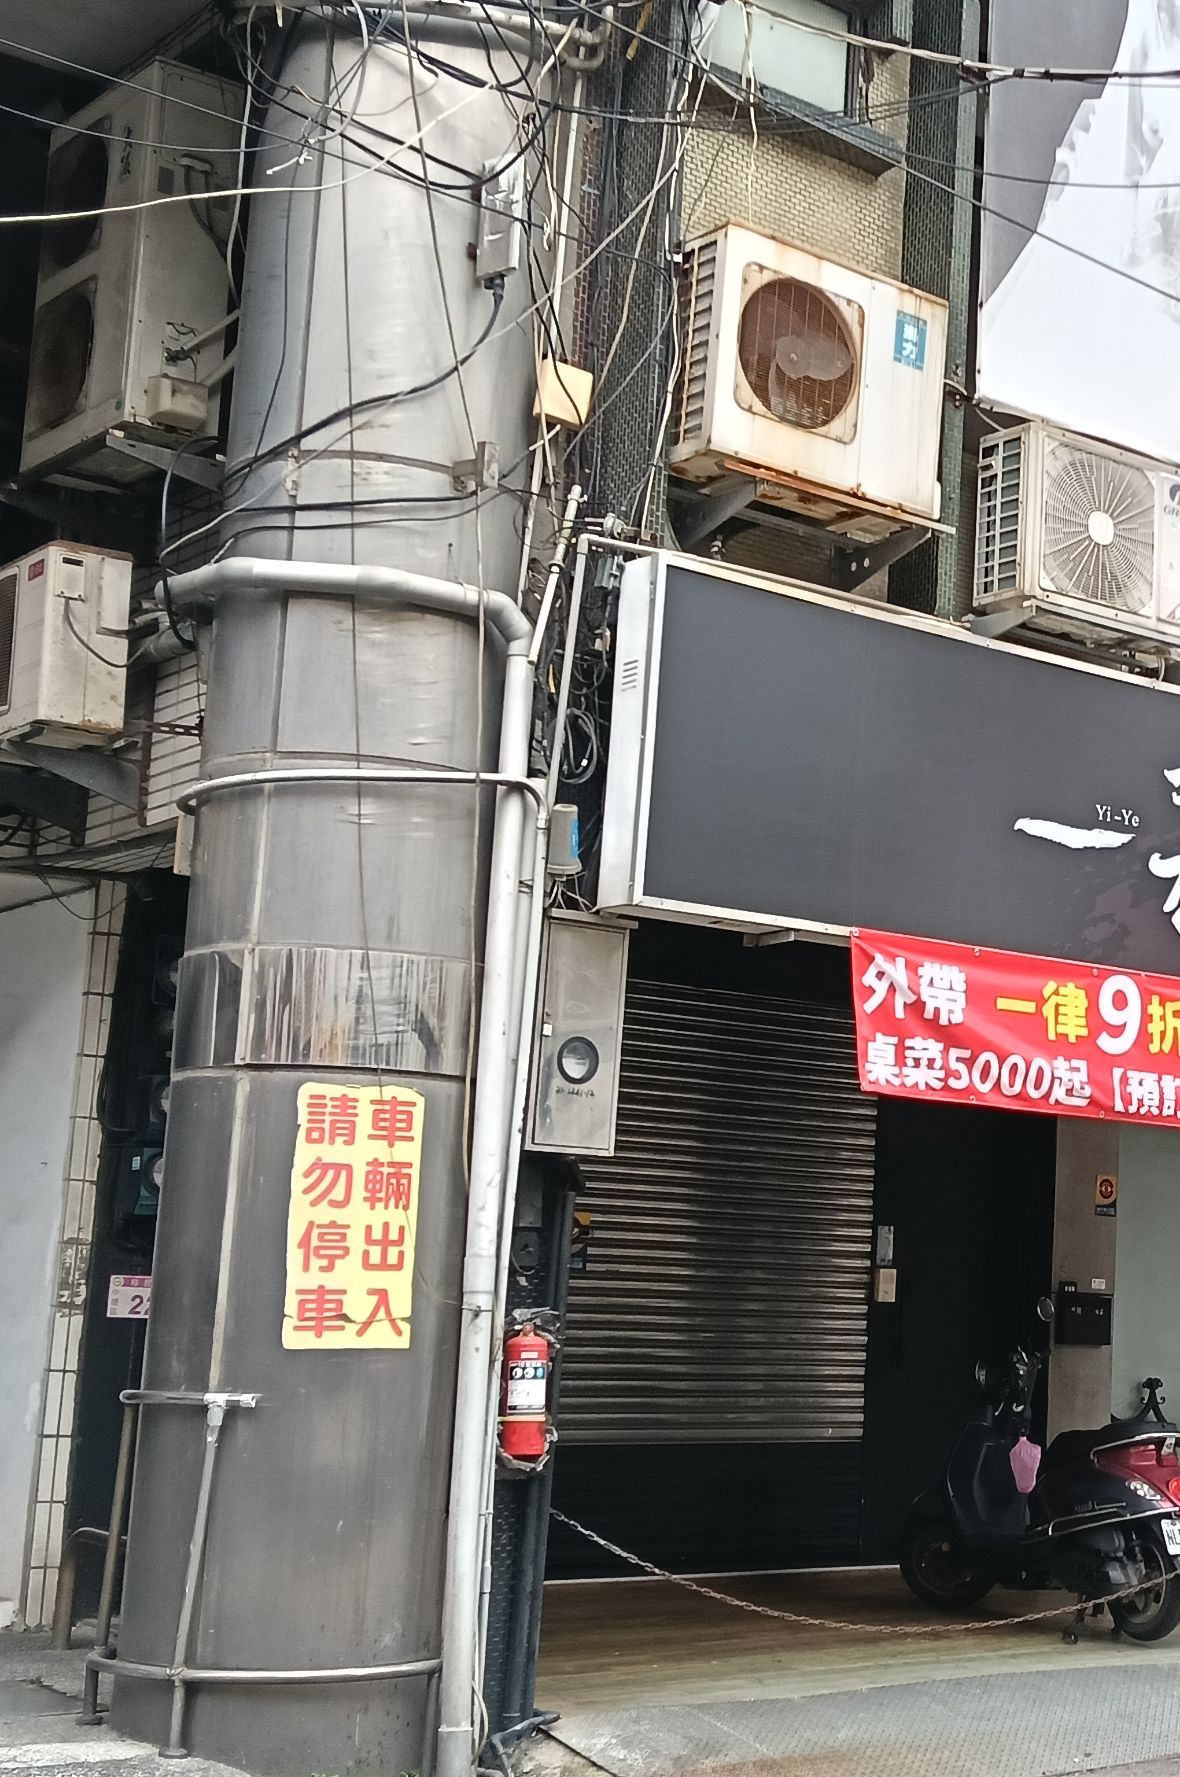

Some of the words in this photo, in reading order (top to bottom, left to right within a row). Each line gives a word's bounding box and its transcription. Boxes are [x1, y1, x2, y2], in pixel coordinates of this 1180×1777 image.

[1095, 805, 1141, 828] Yi-Ye
[861, 952, 967, 1026] 外帶
[864, 1032, 1092, 1107] 桌菜5000起
[292, 1094, 359, 1338] 請勿停車
[355, 1095, 417, 1338] 車輛出入
